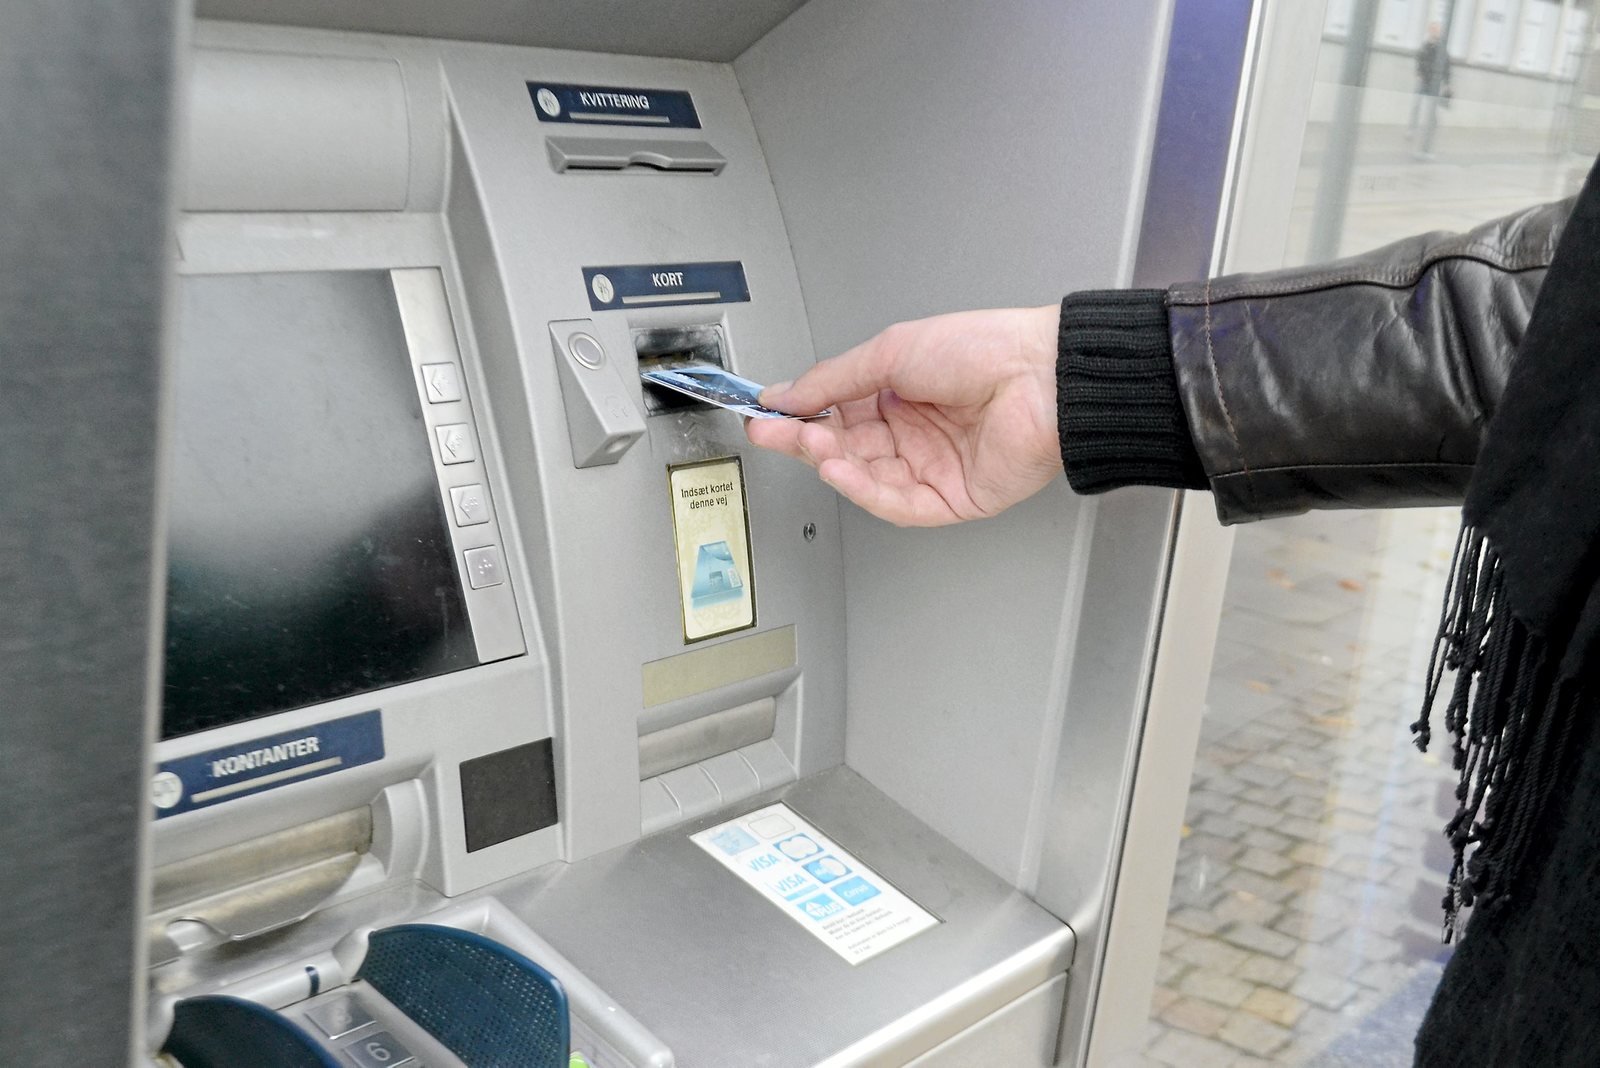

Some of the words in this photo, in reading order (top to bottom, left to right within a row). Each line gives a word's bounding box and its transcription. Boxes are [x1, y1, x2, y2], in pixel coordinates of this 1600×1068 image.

[579, 91, 651, 110] KVITTERING
[652, 271, 684, 287] KORT
[681, 485, 709, 498] Indsæt
[710, 481, 734, 494] kortet
[690, 498, 715, 510] denne
[715, 494, 728, 506] vej
[211, 735, 320, 778] KONTANTER
[748, 853, 781, 872] VISA
[776, 873, 807, 893] VISA
[366, 1041, 391, 1062] 6
